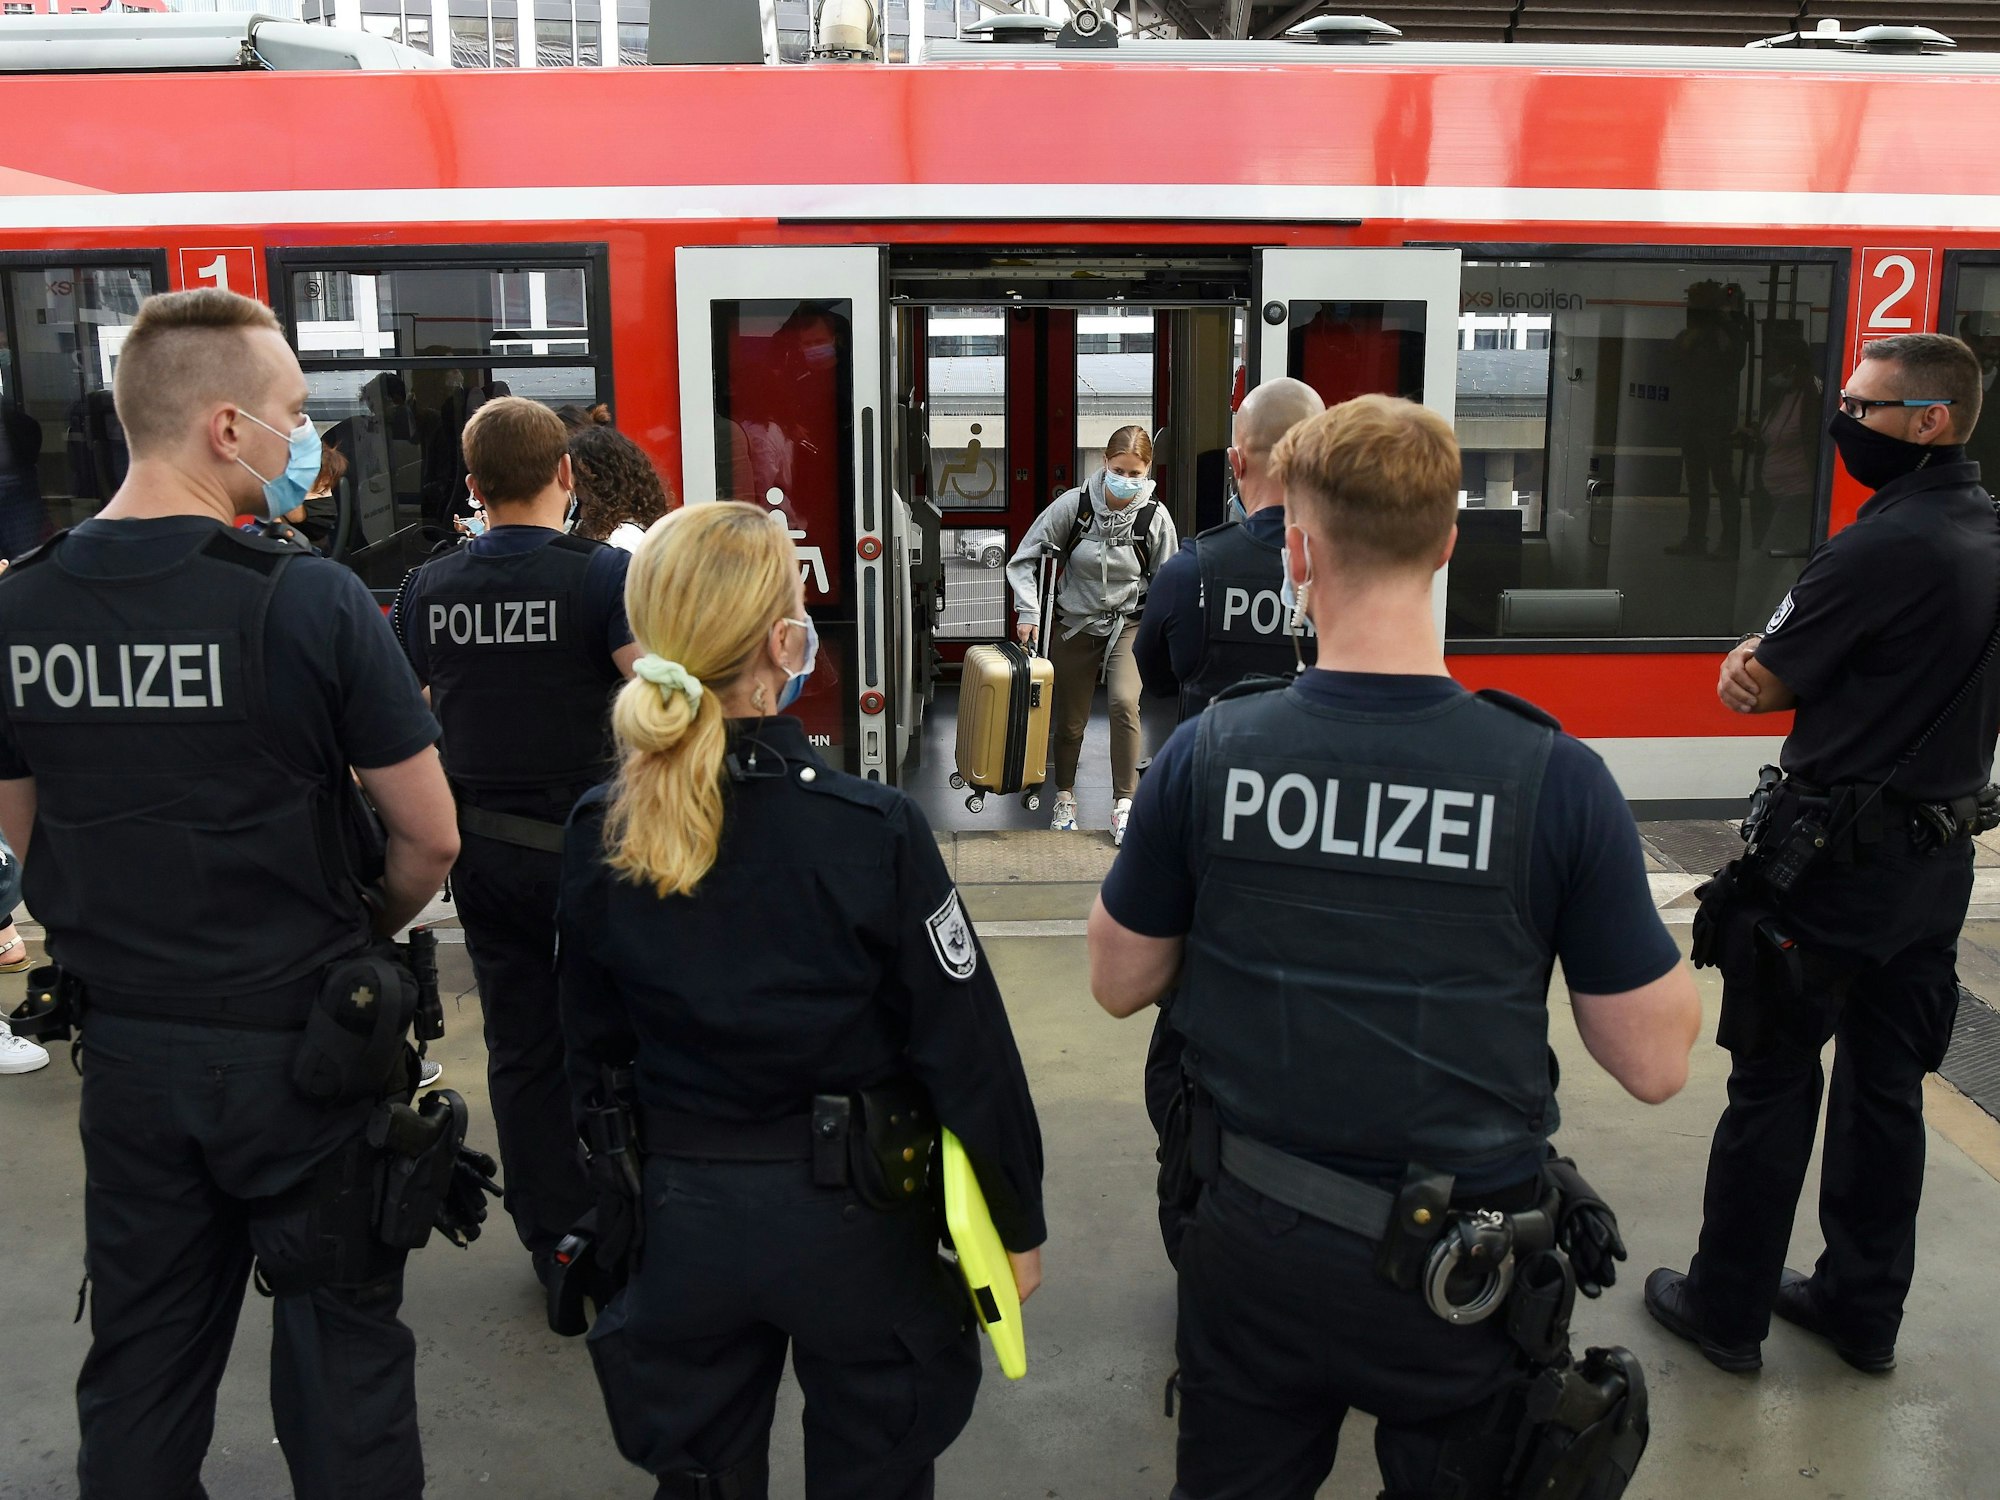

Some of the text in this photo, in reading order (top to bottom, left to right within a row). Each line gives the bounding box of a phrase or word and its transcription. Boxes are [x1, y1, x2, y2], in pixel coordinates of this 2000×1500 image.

[198, 255, 228, 291] 1
[1867, 254, 1916, 329] 2
[429, 600, 557, 645] POLIZEI
[1222, 587, 1316, 638] POL
[9, 643, 224, 708] POLIZEI
[1222, 767, 1496, 872] POLIZEI
